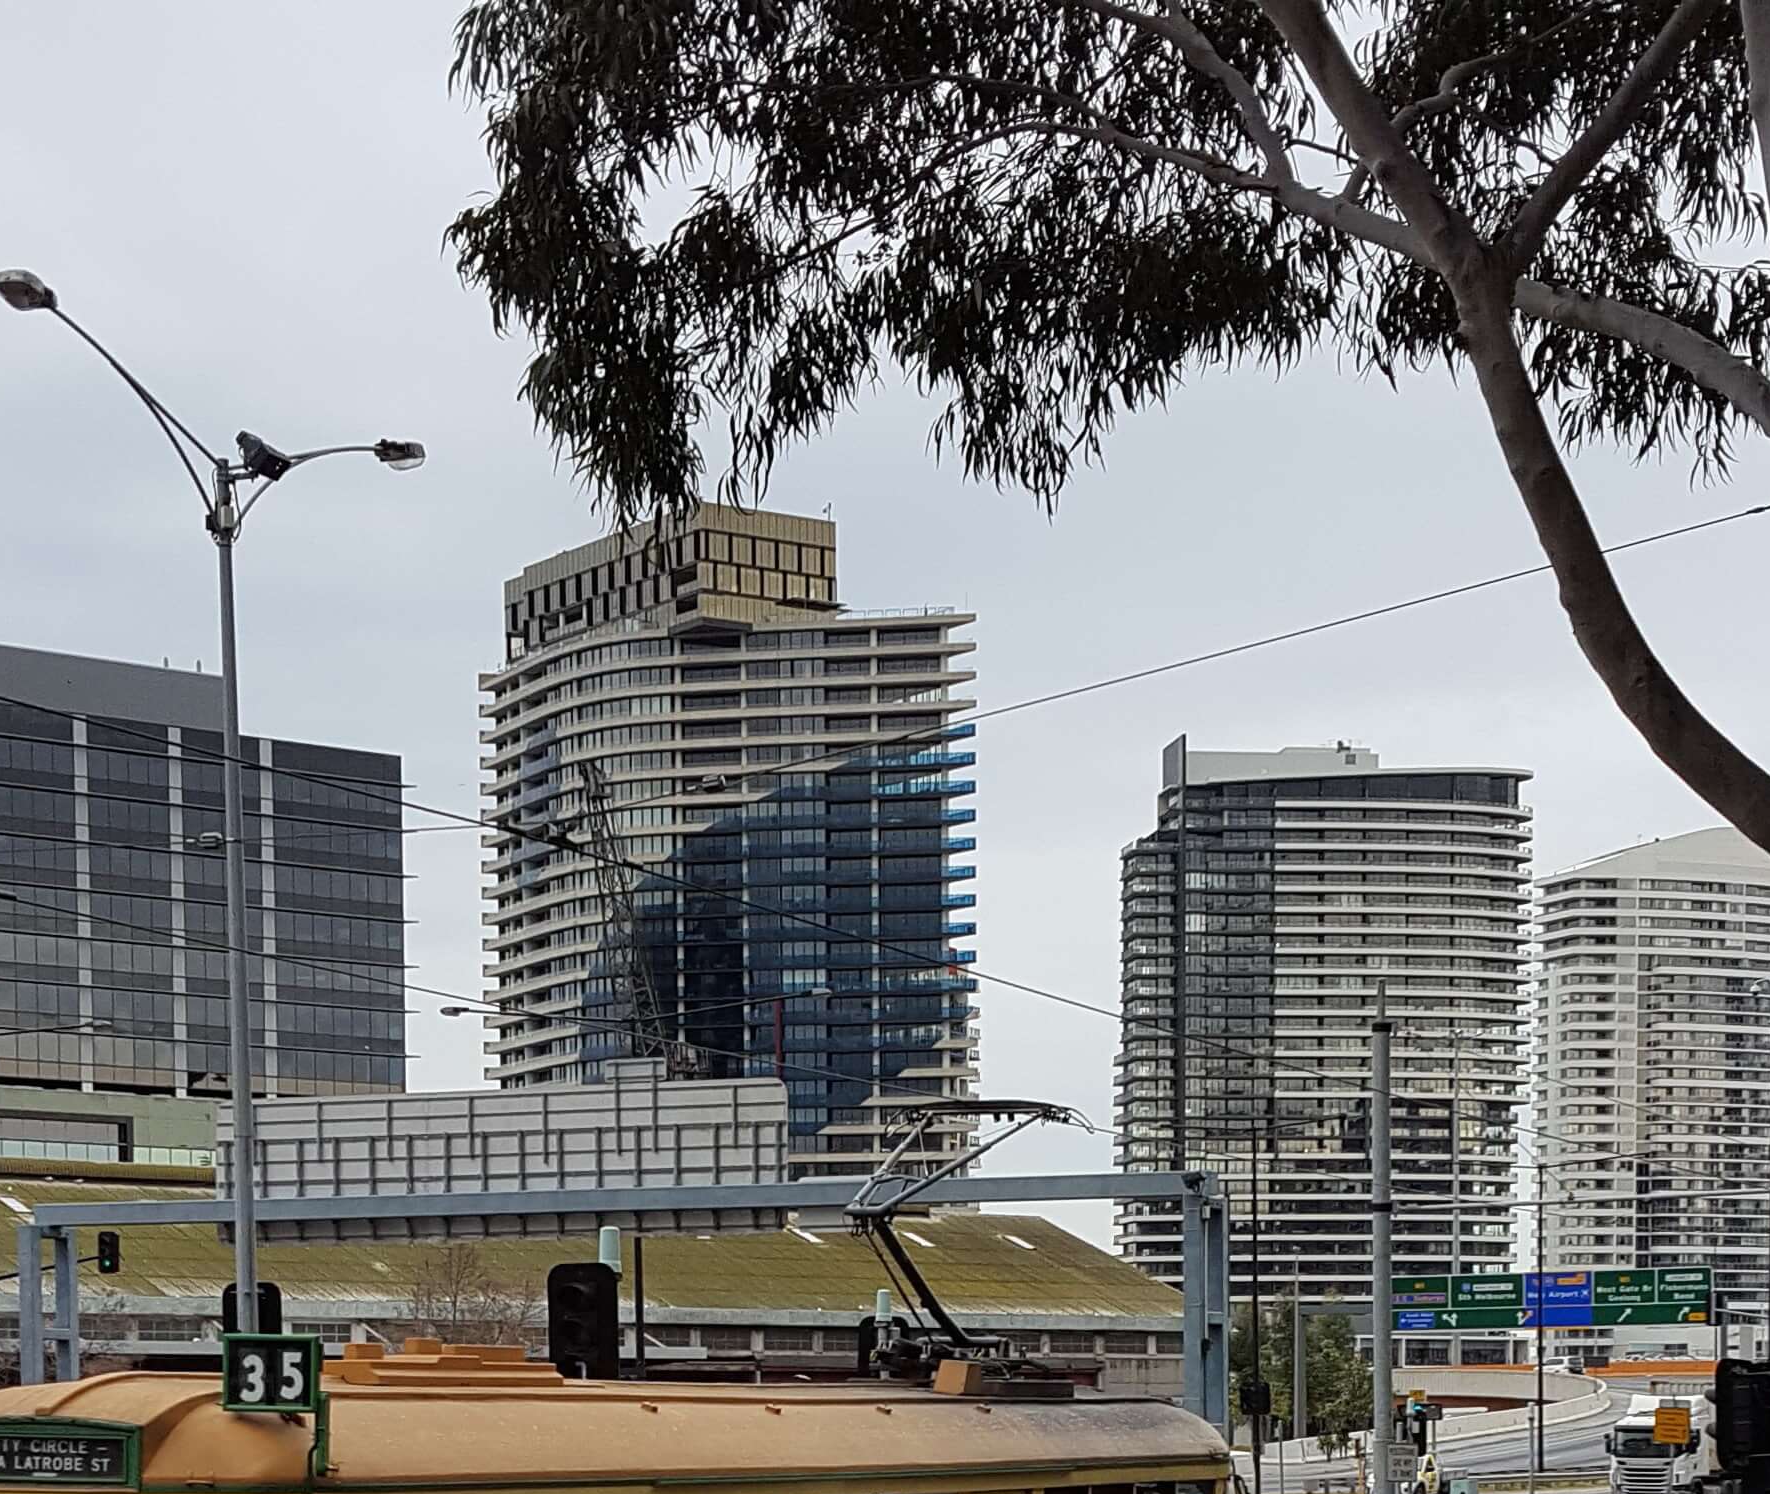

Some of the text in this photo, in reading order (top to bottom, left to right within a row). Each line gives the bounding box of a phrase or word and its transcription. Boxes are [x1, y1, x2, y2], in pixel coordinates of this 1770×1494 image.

[1548, 1290, 1579, 1299] Airport
[239, 1351, 304, 1402] 35
[30, 1439, 89, 1454] CIRCLE
[13, 1455, 84, 1472] LATROBE
[90, 1457, 112, 1473] ST
